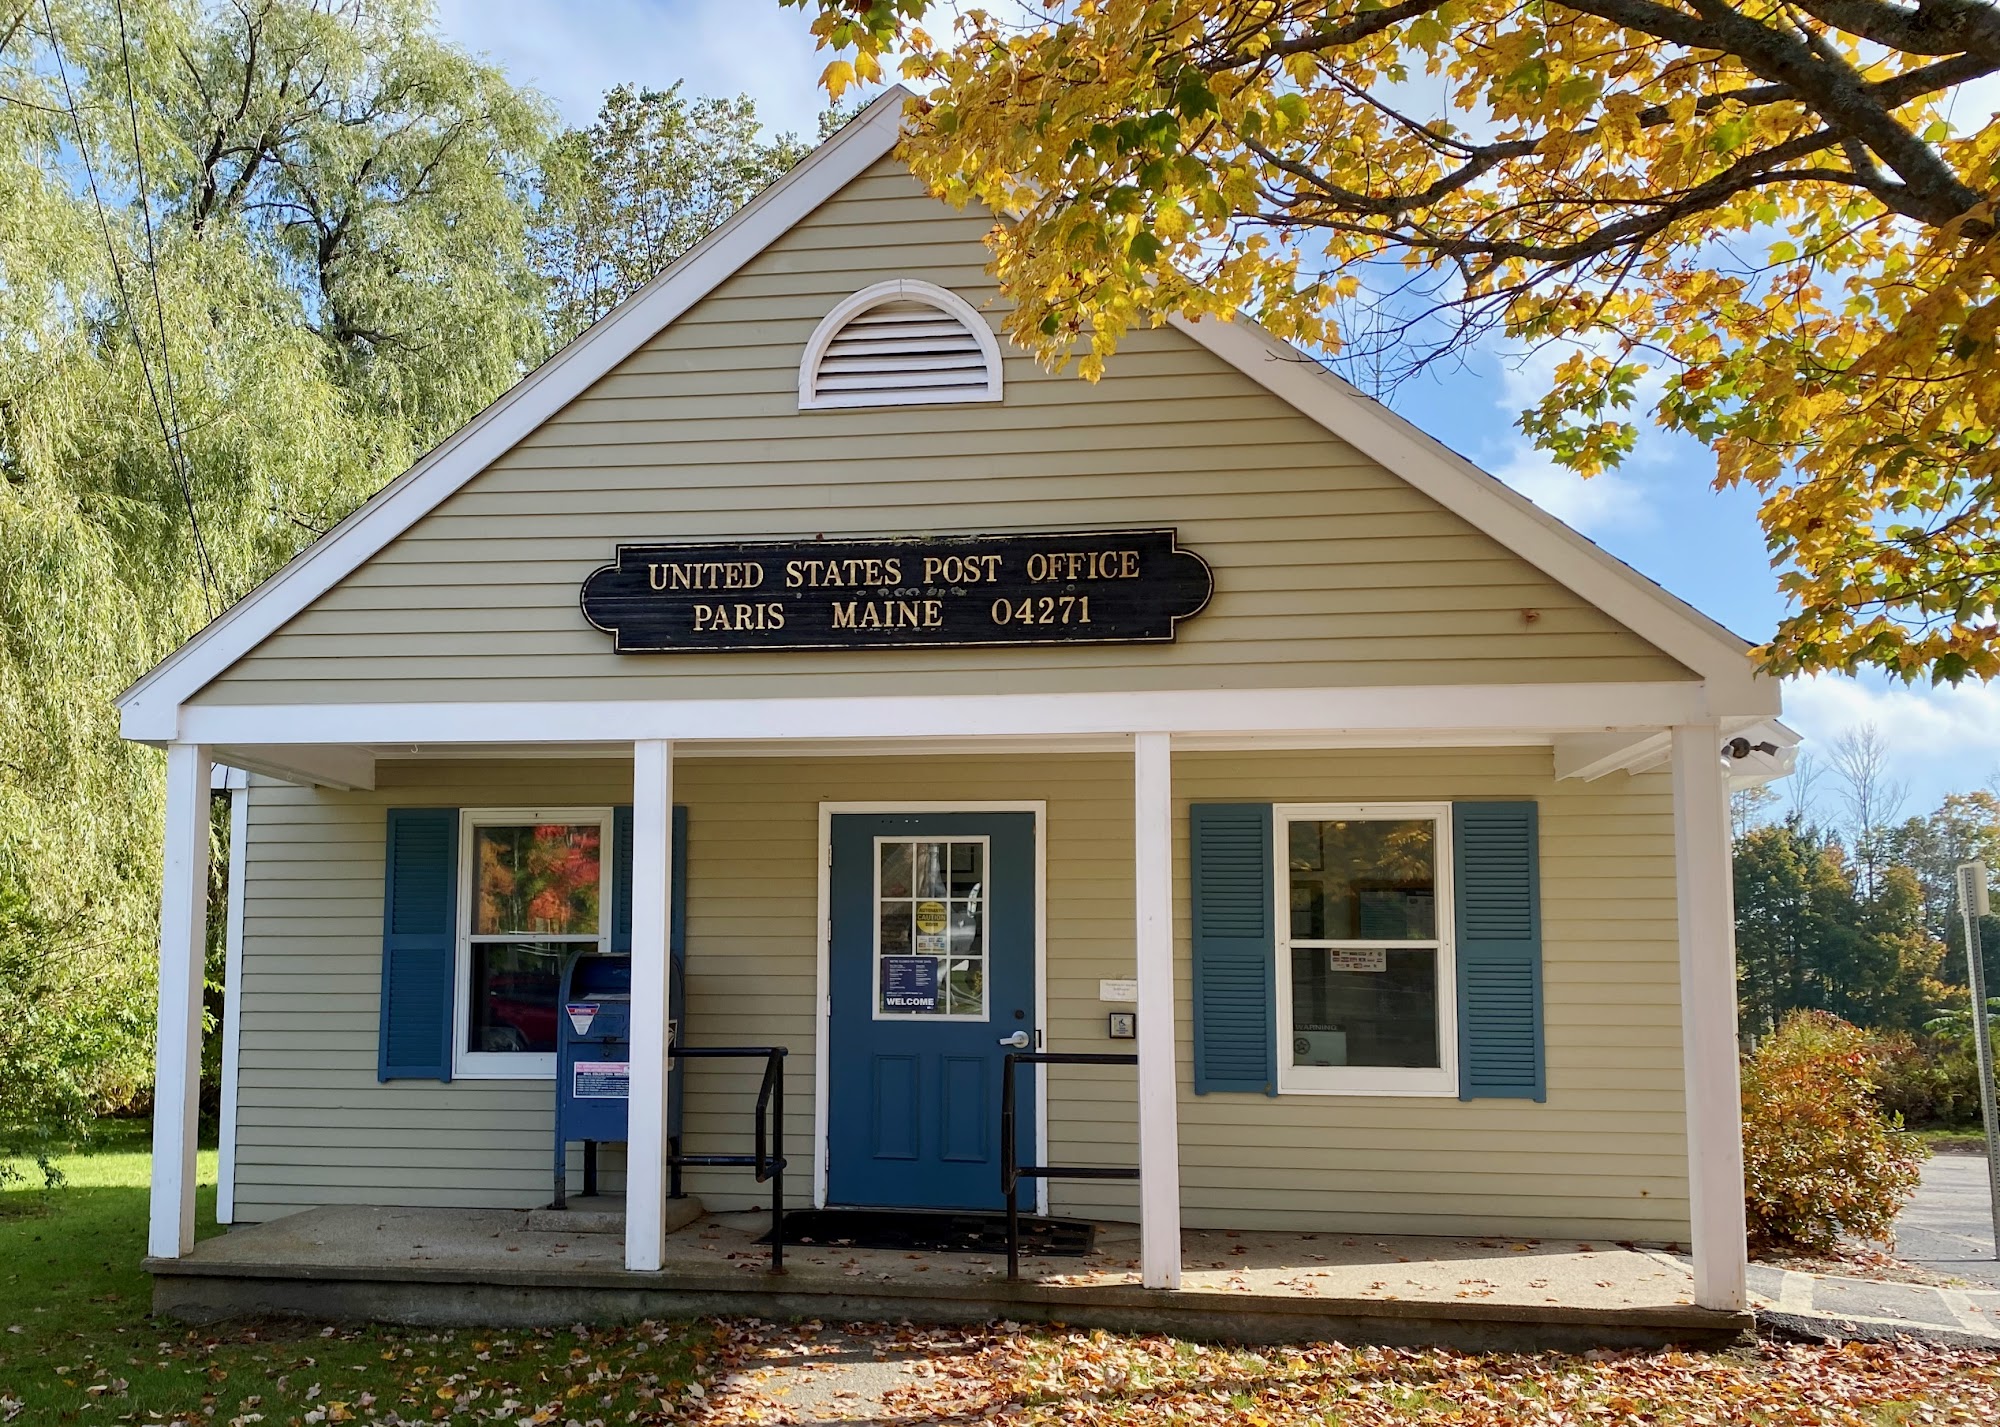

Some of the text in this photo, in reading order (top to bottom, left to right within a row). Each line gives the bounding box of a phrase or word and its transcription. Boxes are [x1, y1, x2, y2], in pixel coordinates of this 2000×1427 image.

[648, 551, 1140, 591] UNITED STATES POST OFFICE
[693, 596, 1092, 631] PARIS MAINE 04271
[886, 997, 934, 1006] WELCOME
